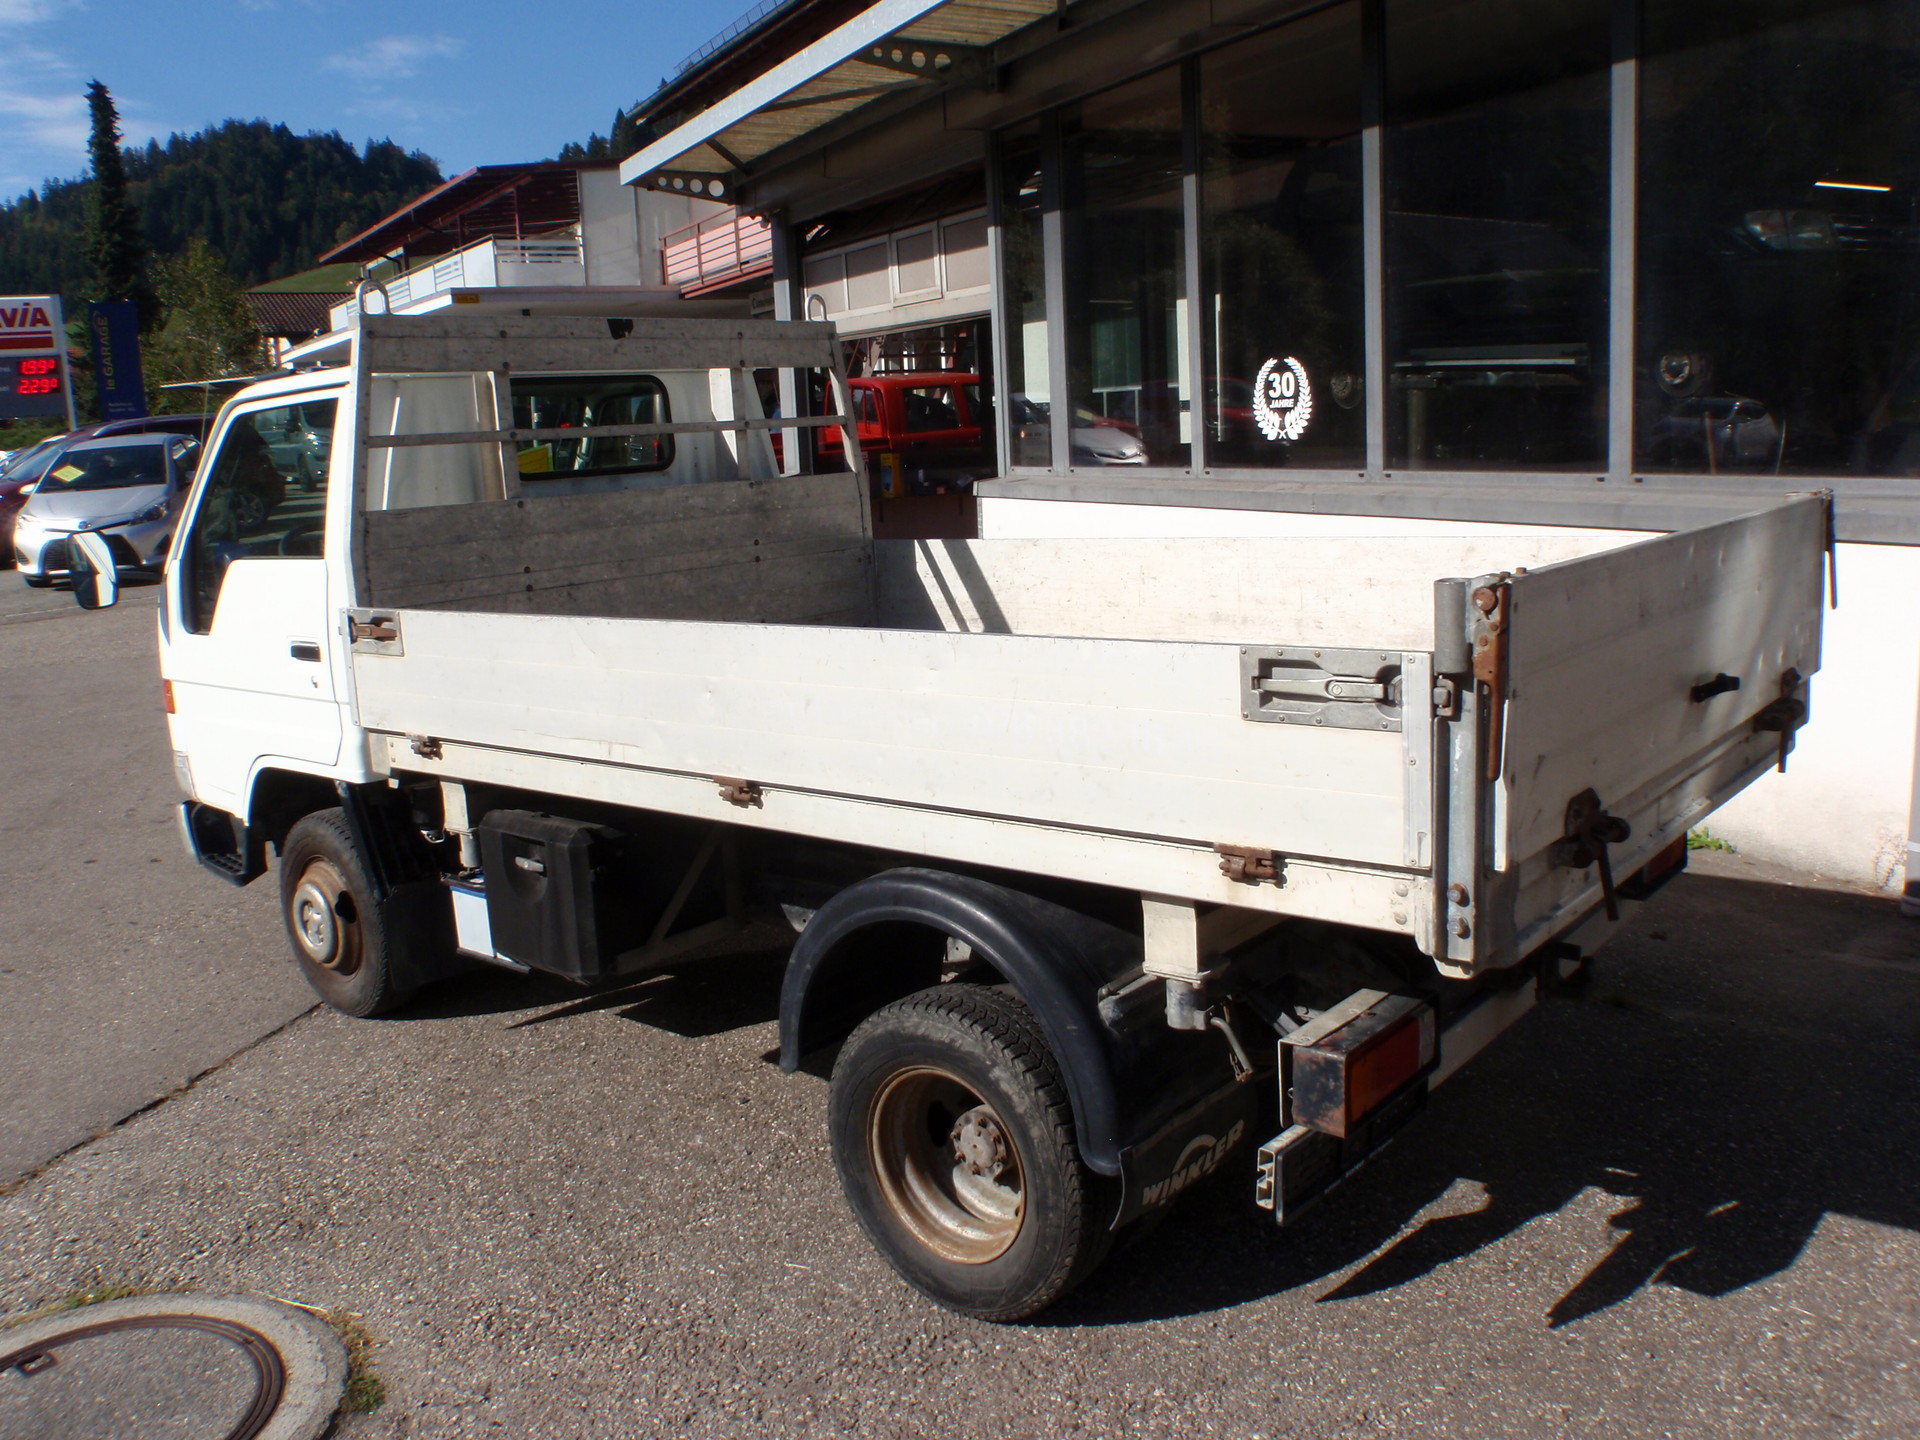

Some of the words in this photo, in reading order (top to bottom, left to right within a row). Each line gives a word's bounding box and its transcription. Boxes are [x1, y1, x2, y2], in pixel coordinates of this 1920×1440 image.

[0, 303, 51, 328] VIA
[97, 317, 114, 377] GARAGE
[1268, 371, 1295, 398] 30
[1269, 398, 1295, 408] JAHRE
[1142, 1119, 1244, 1206] WINKLER
